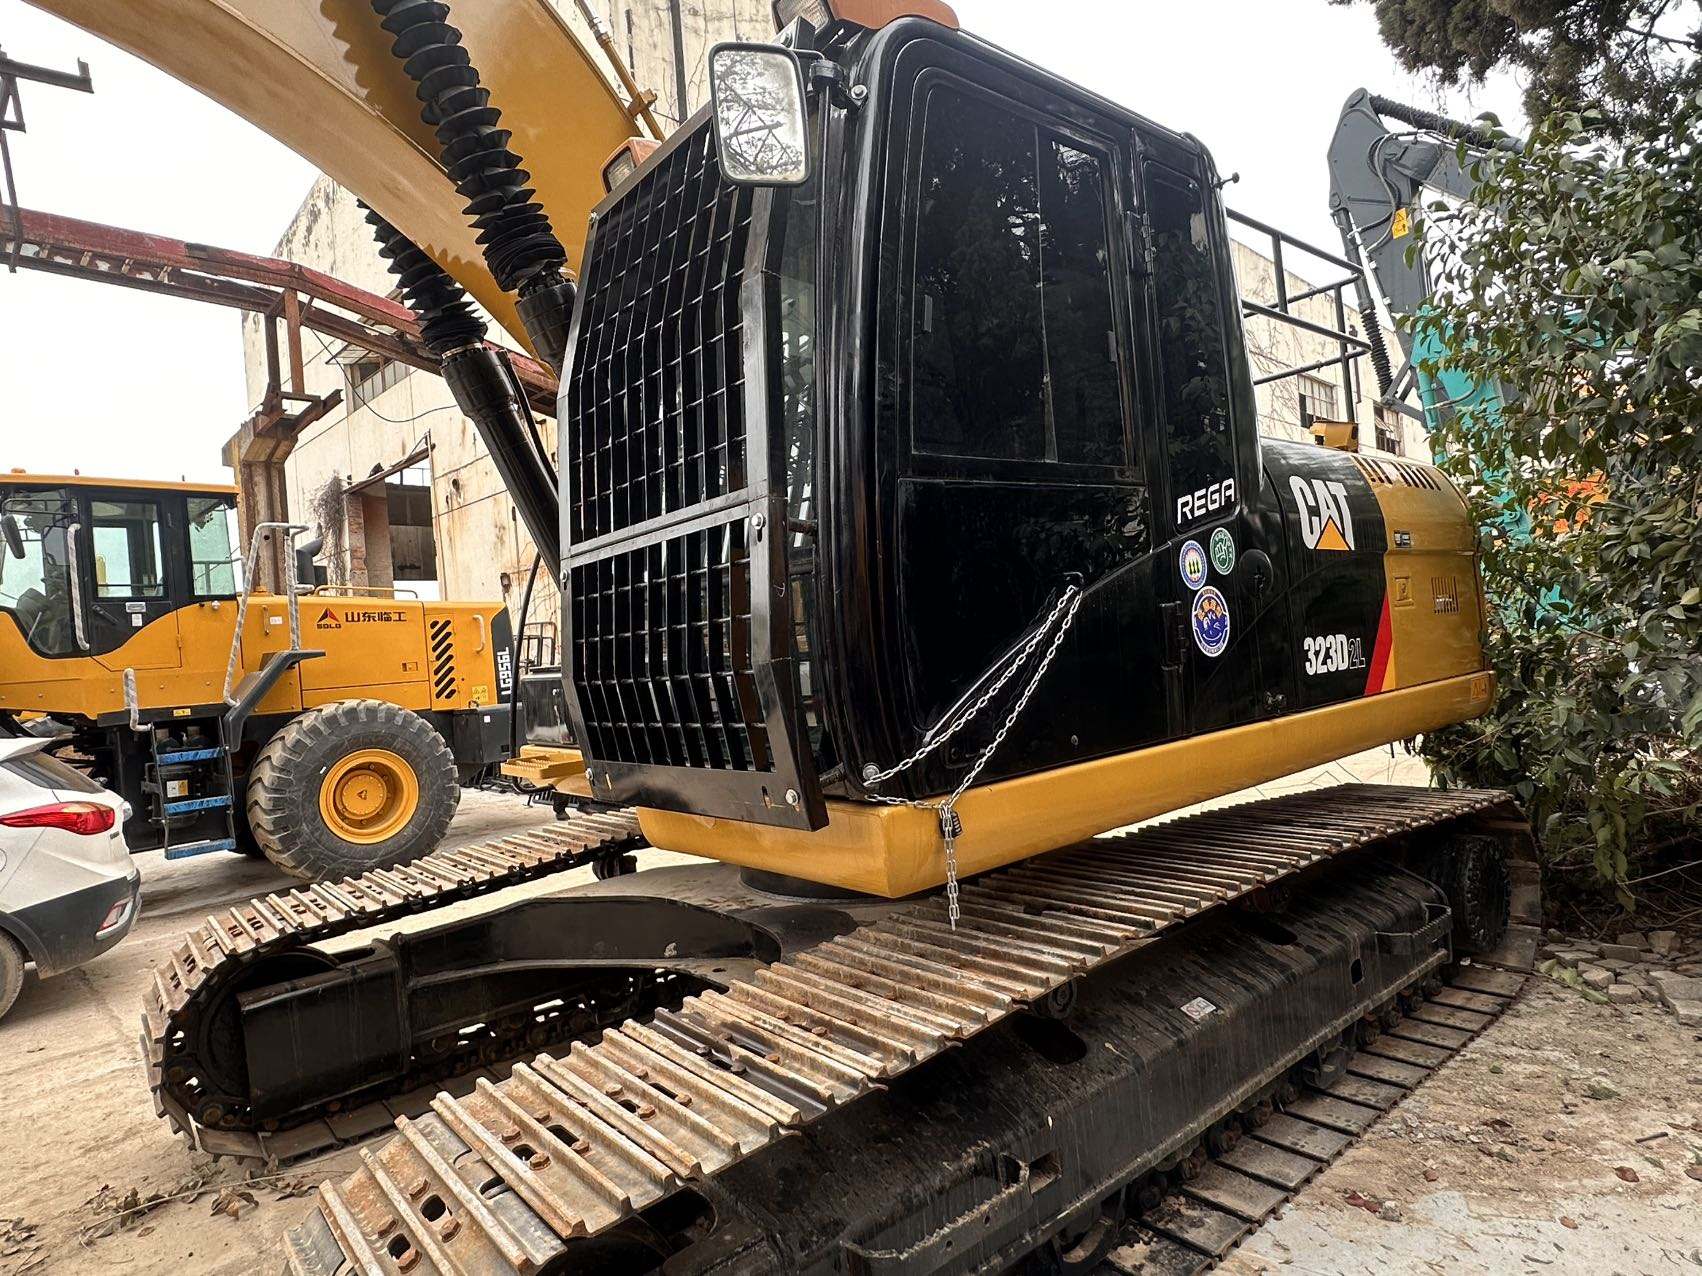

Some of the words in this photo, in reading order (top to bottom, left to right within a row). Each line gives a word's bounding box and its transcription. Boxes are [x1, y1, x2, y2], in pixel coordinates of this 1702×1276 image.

[1177, 478, 1235, 525] REGA
[1289, 475, 1354, 550] CAT
[345, 611, 407, 622] 山东临工
[496, 646, 513, 695] LG956L
